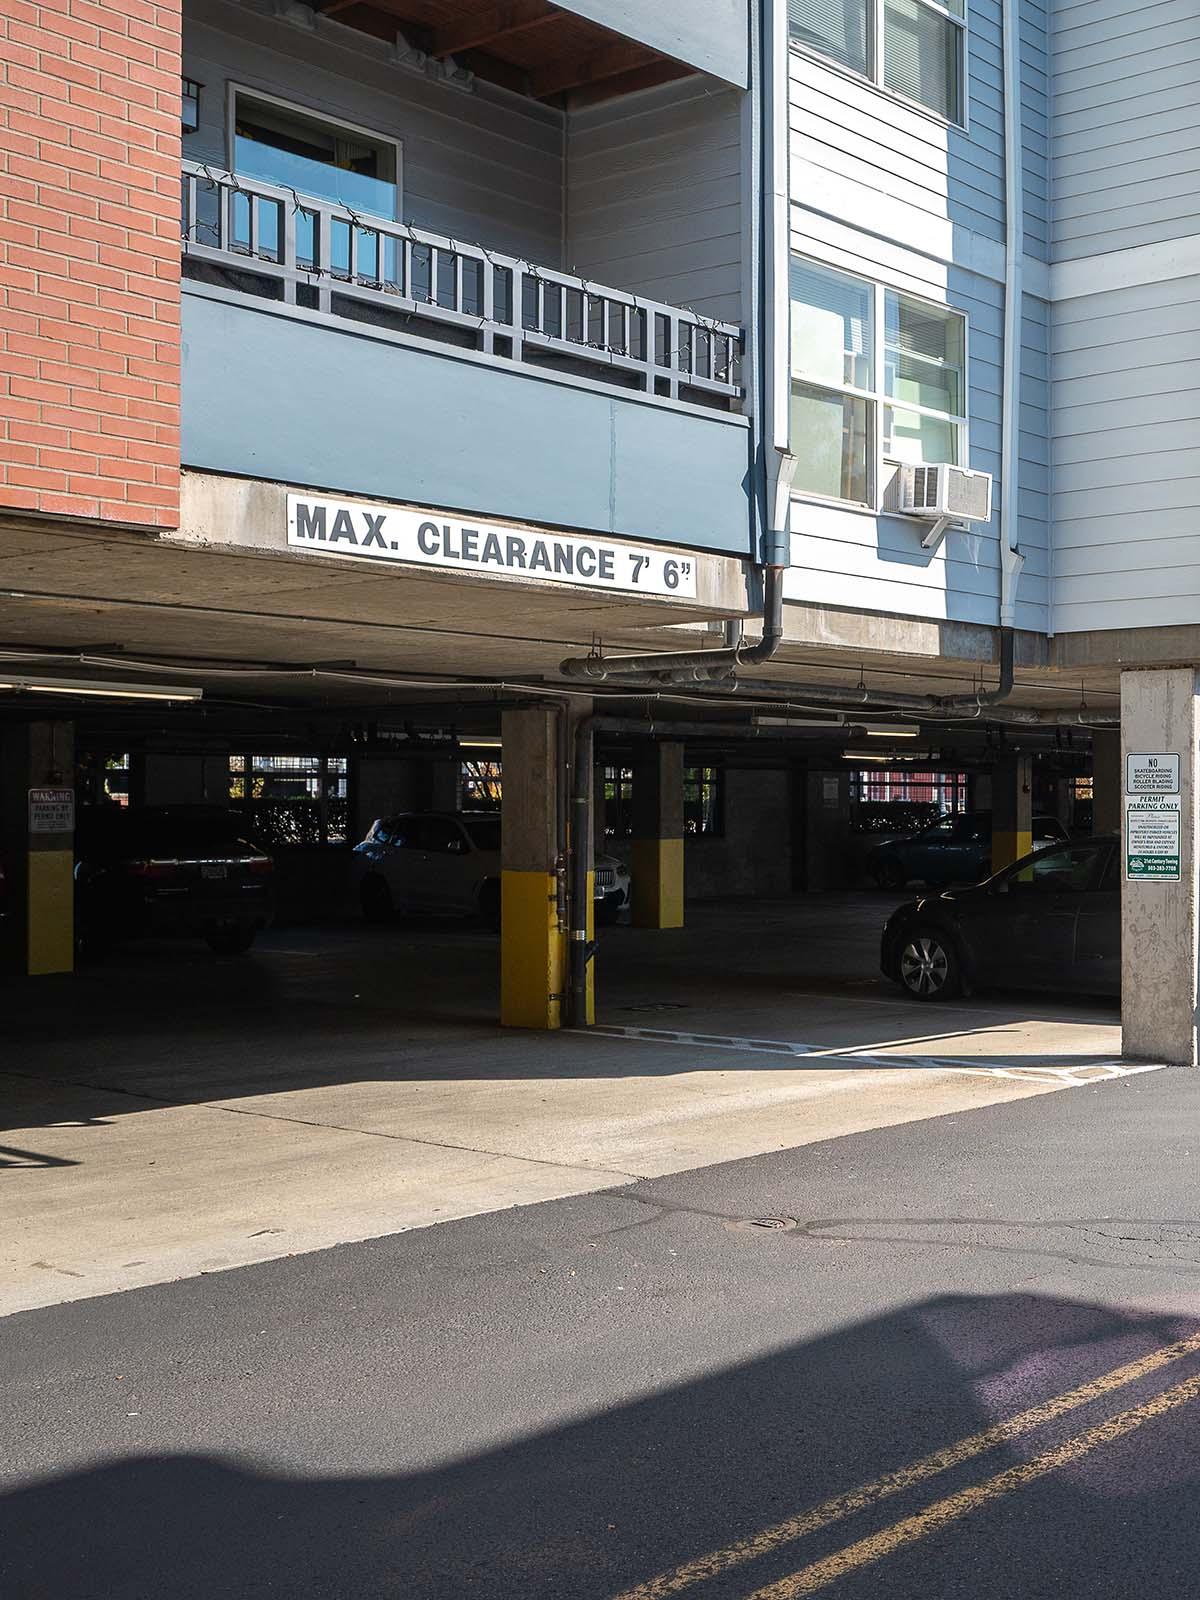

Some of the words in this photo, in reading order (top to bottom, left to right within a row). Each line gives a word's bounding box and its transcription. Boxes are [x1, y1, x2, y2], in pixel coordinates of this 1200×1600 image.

[297, 503, 398, 550] MAX.
[417, 522, 614, 580] CLEARANCE
[1148, 758, 1158, 767] NO
[32, 792, 71, 800] WARNING
